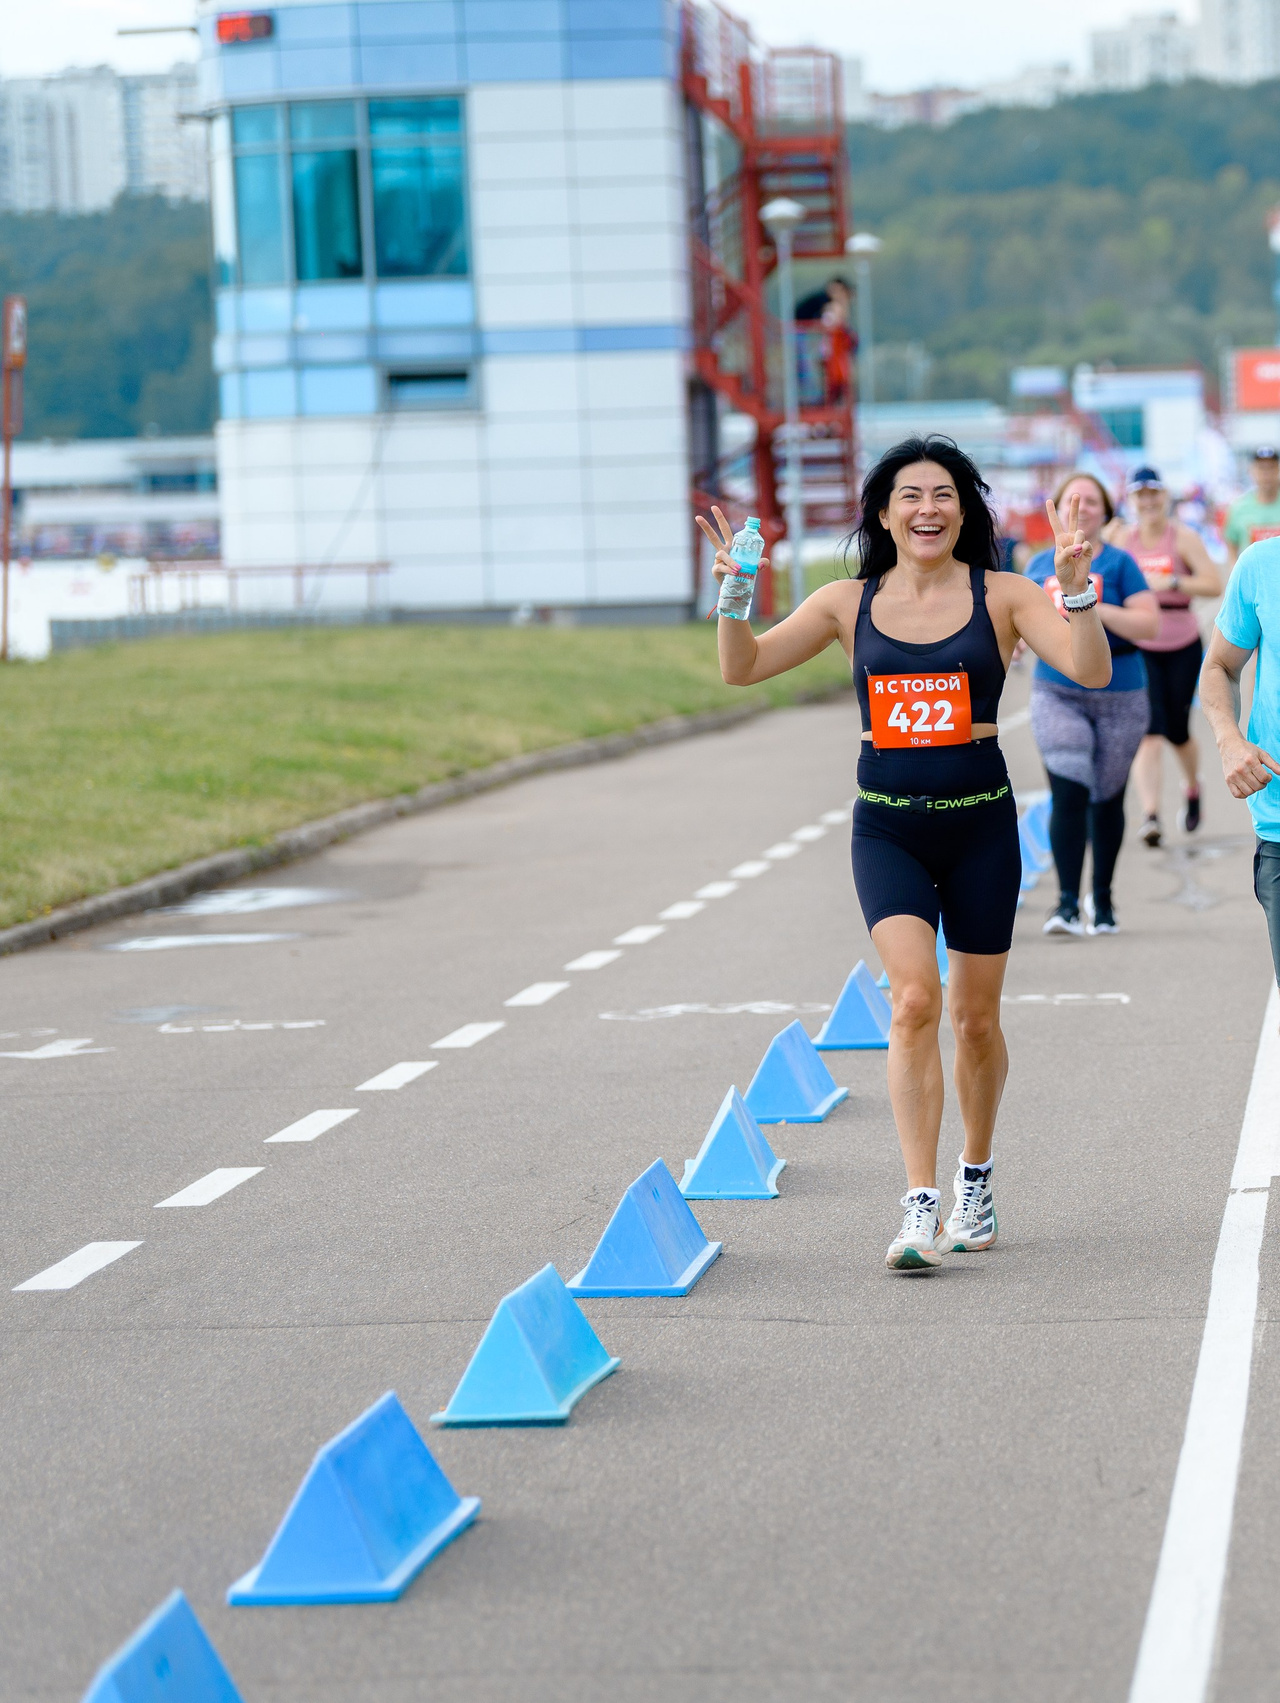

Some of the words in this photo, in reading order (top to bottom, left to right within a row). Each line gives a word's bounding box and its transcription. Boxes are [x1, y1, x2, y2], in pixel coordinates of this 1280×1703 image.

[874, 680, 884, 694] Я
[887, 680, 898, 694] С
[901, 676, 961, 693] ТОБОЙ
[887, 700, 955, 733] 422
[910, 737, 919, 745] 10
